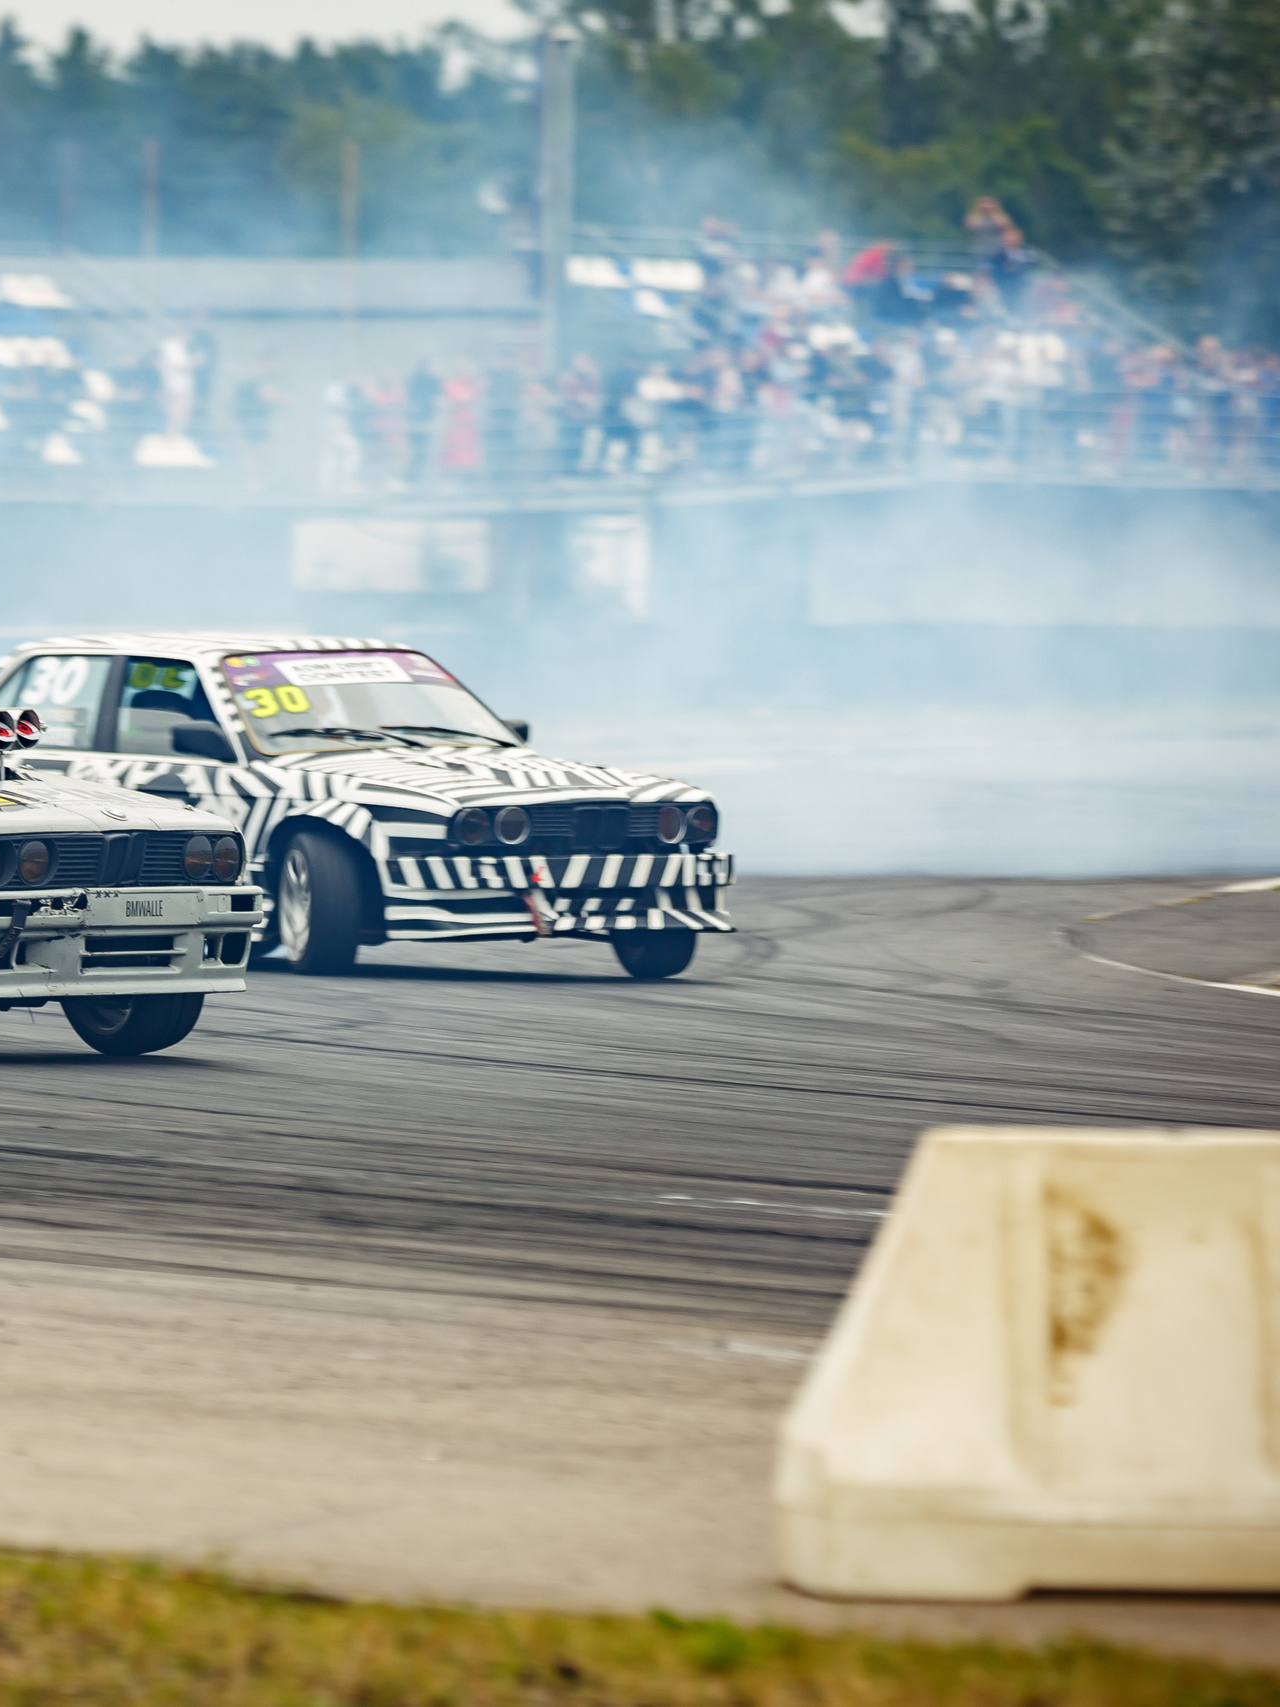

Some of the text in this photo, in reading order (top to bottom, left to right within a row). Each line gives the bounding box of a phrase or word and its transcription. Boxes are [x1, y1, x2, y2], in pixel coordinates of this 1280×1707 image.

[21, 656, 88, 705] 30
[243, 684, 310, 718] 30
[125, 900, 163, 917] BMWALLE
